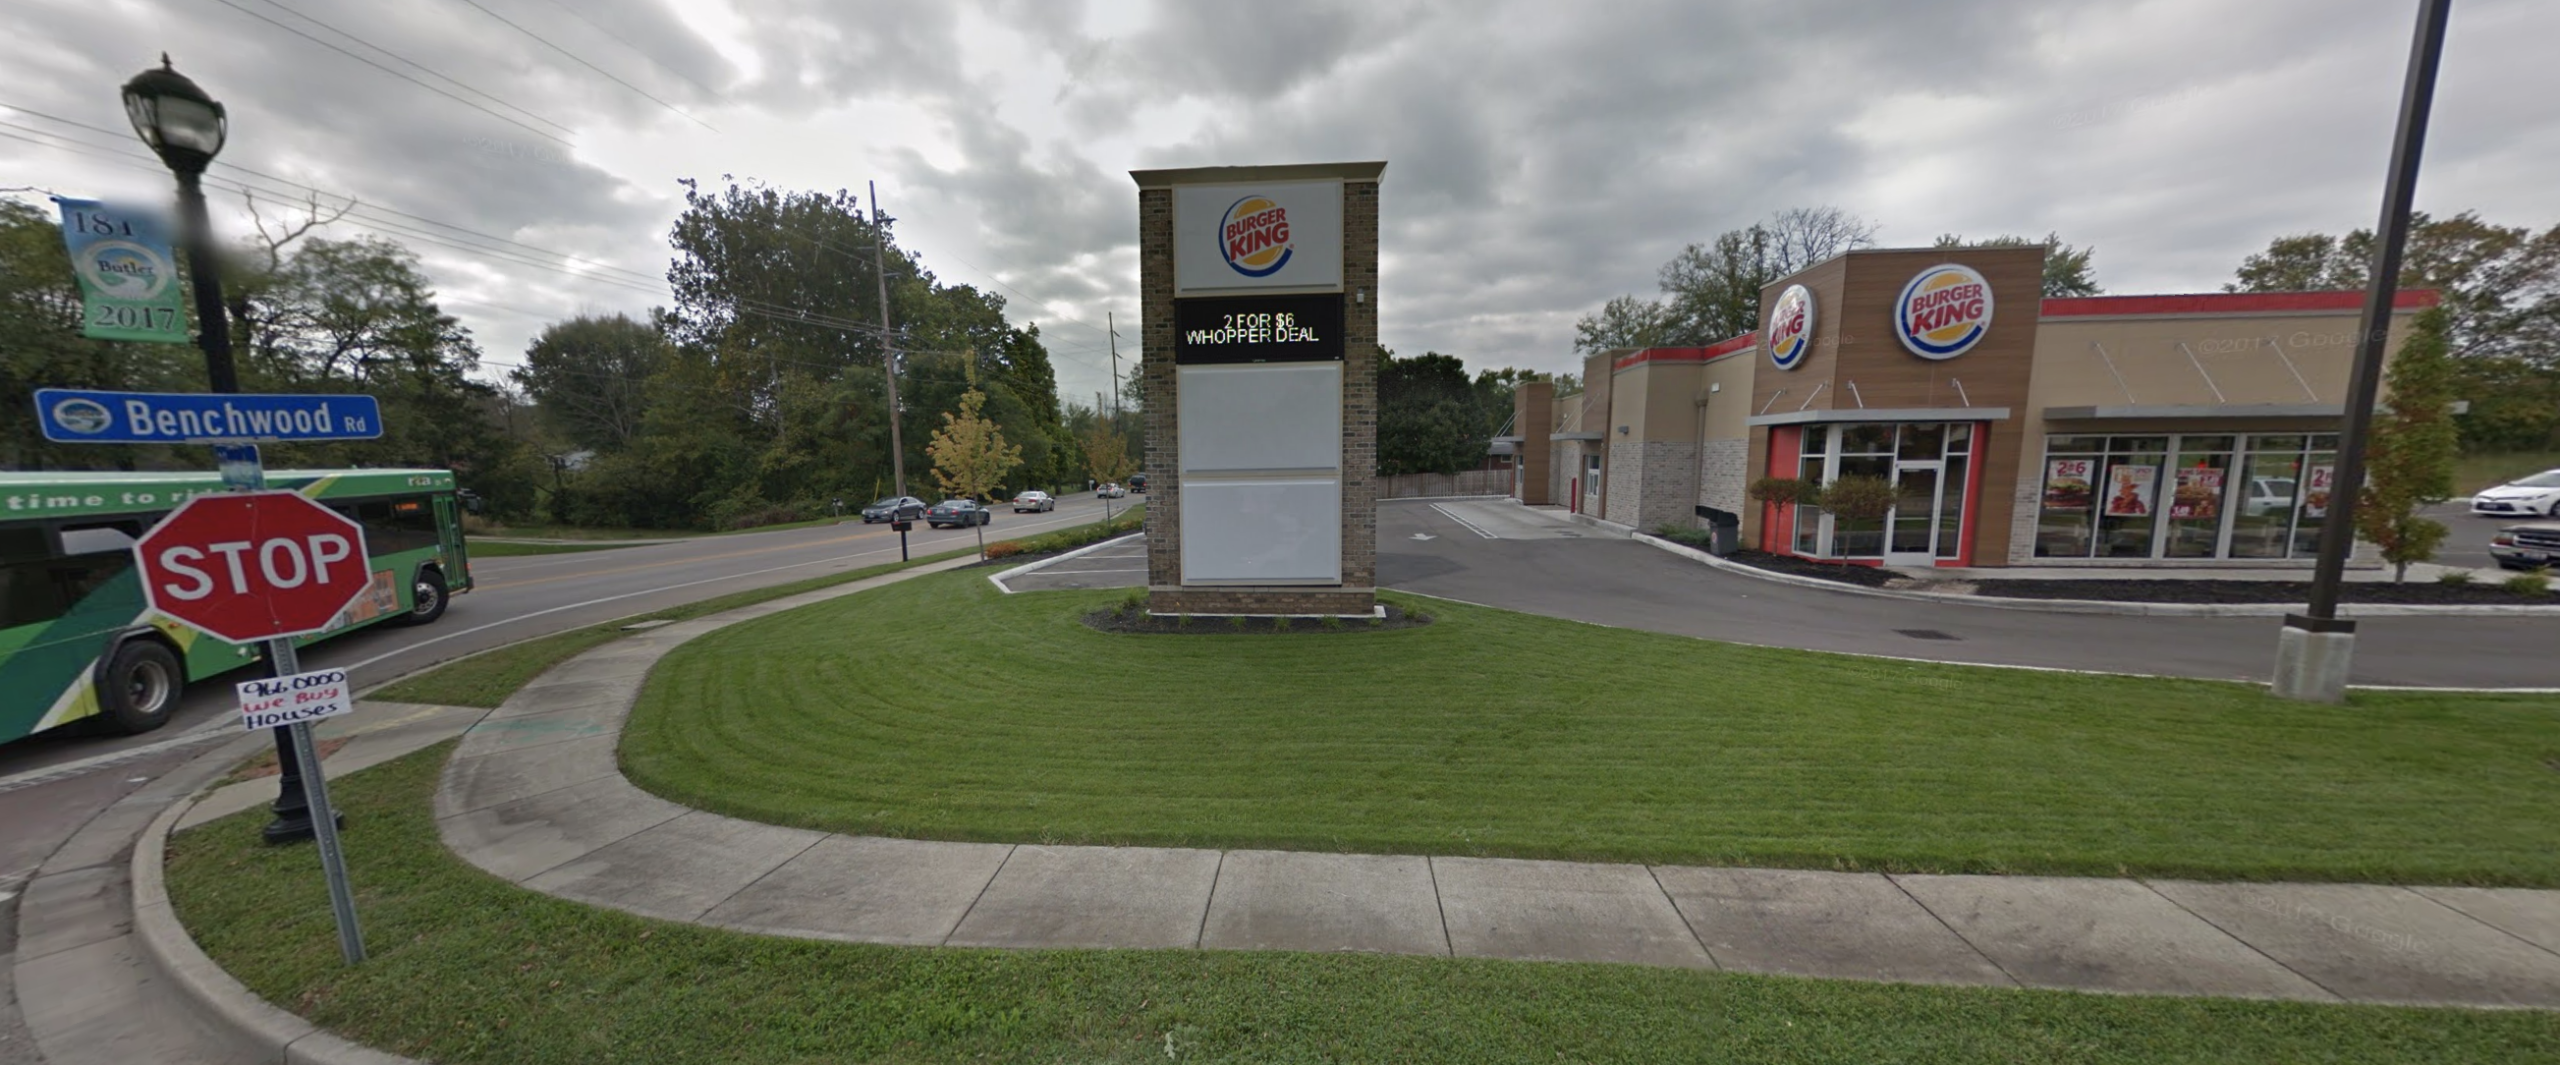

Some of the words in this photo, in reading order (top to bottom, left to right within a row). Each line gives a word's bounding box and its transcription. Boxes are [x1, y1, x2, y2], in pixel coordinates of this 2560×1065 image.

[75, 211, 134, 237] 181
[1227, 207, 1286, 241] BURGER
[1230, 221, 1289, 261] KING
[98, 260, 154, 274] Butler
[1912, 284, 1983, 314] BURGER
[94, 305, 175, 331] 2017
[1224, 314, 1232, 329] 2
[1237, 313, 1271, 328] FOR
[1275, 312, 1295, 328] $6
[1770, 313, 1805, 349] KING
[1911, 298, 1984, 336] KING
[1186, 328, 1271, 345] WHOPPER
[1276, 327, 1319, 343] DEAL
[125, 401, 332, 436] Benchwood
[345, 416, 367, 433] Rd
[7, 494, 104, 510] time
[122, 491, 155, 505] to
[160, 534, 350, 600] STOP
[243, 681, 288, 697] 966
[293, 671, 345, 690] 0000
